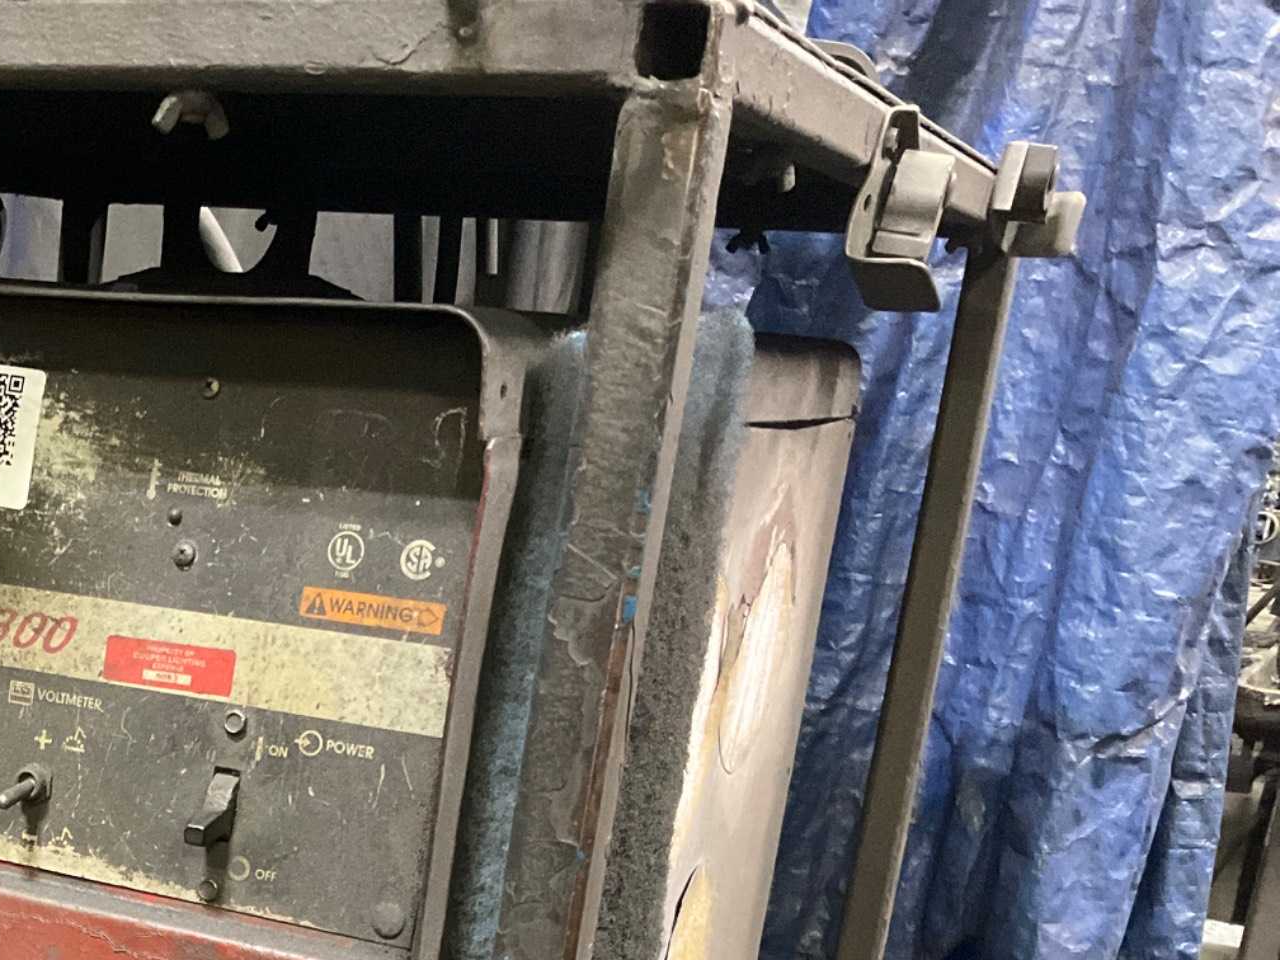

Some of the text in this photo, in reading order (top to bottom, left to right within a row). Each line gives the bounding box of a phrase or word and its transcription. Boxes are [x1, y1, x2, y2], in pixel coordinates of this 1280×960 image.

[166, 482, 228, 500] PROTECTION
[329, 596, 414, 623] WARNING
[37, 687, 104, 713] VOLTMETER
[269, 744, 289, 758] ON
[326, 739, 375, 760] POWER
[254, 869, 278, 882] OFF
